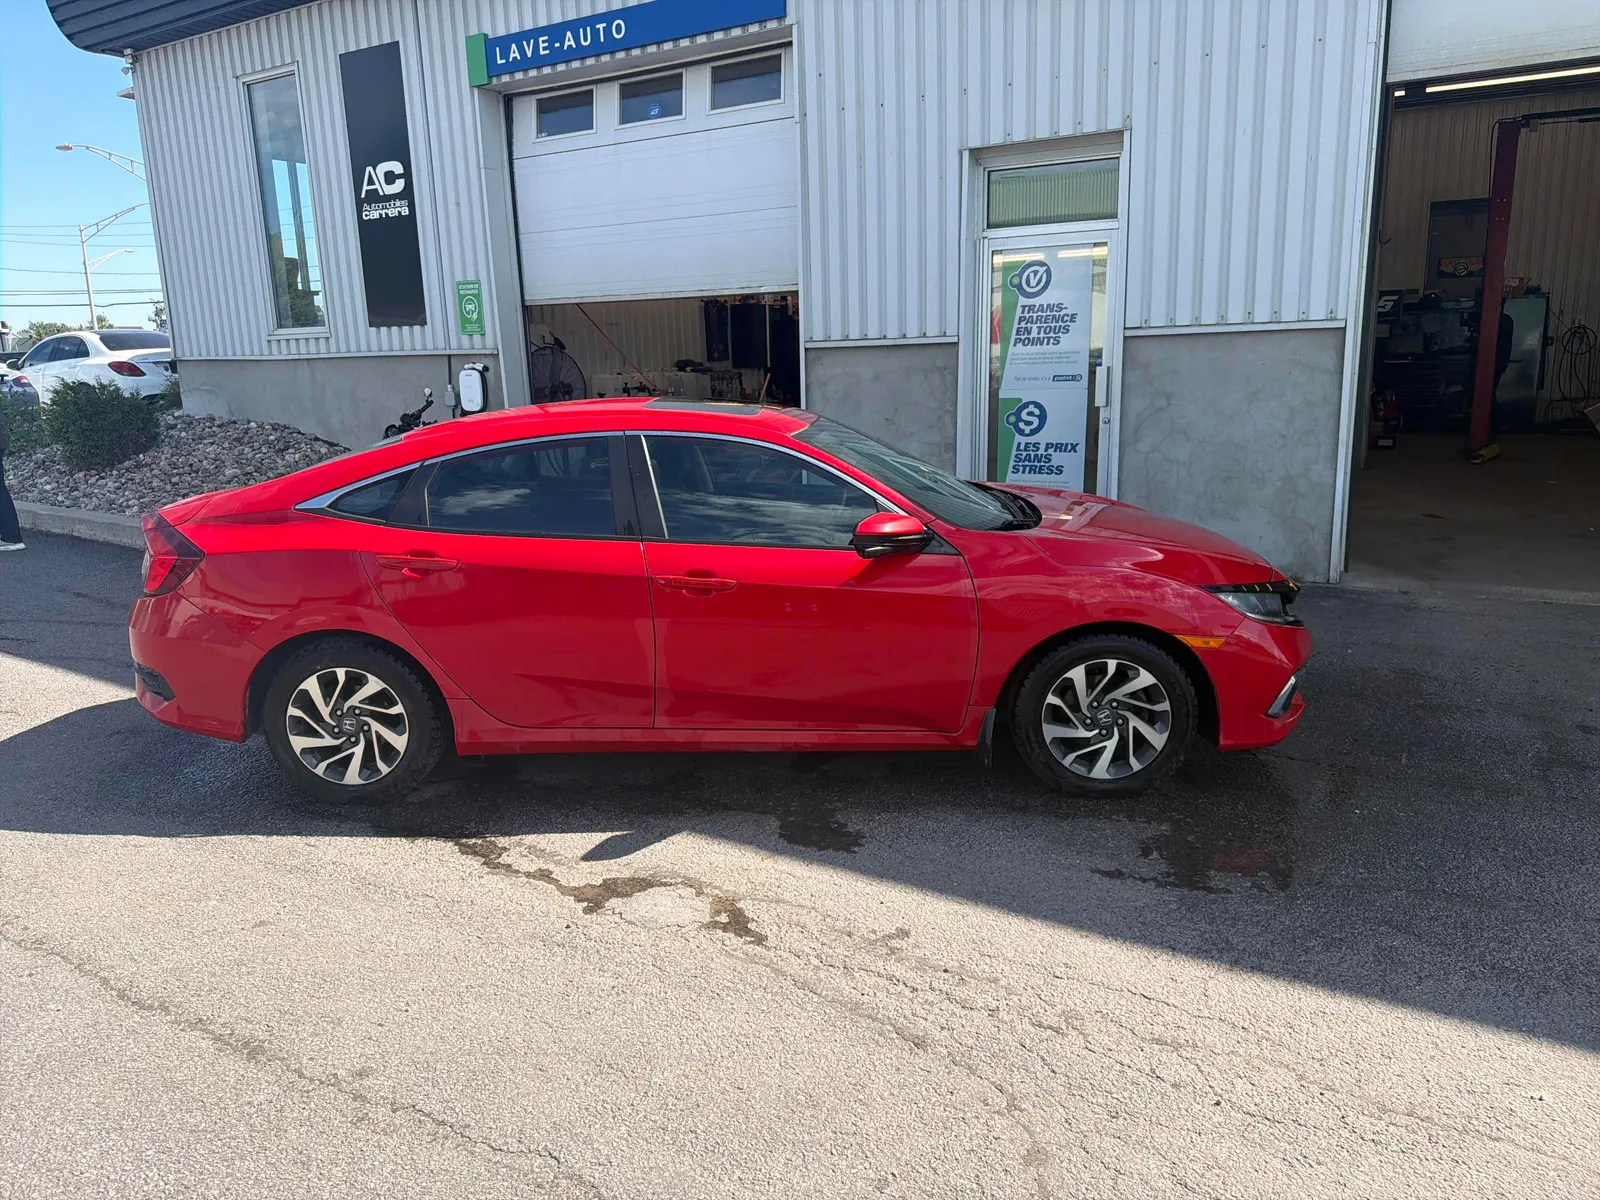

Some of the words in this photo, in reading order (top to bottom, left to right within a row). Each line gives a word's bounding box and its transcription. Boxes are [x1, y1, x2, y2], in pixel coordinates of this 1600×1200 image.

[495, 19, 626, 65] LAVE-AUTO
[361, 160, 406, 198] AC
[362, 199, 409, 211] Automobiles
[362, 206, 410, 220] carrera
[1020, 302, 1068, 315] TRANS-
[1017, 313, 1078, 326] PARENCE
[1015, 326, 1033, 337] EN
[1036, 324, 1071, 336] TOUS
[1012, 335, 1062, 348] POINTS
[1015, 442, 1041, 453] LES
[1044, 442, 1080, 454] PRIX
[1013, 453, 1053, 464] SANS
[1011, 464, 1065, 476] STRESS
